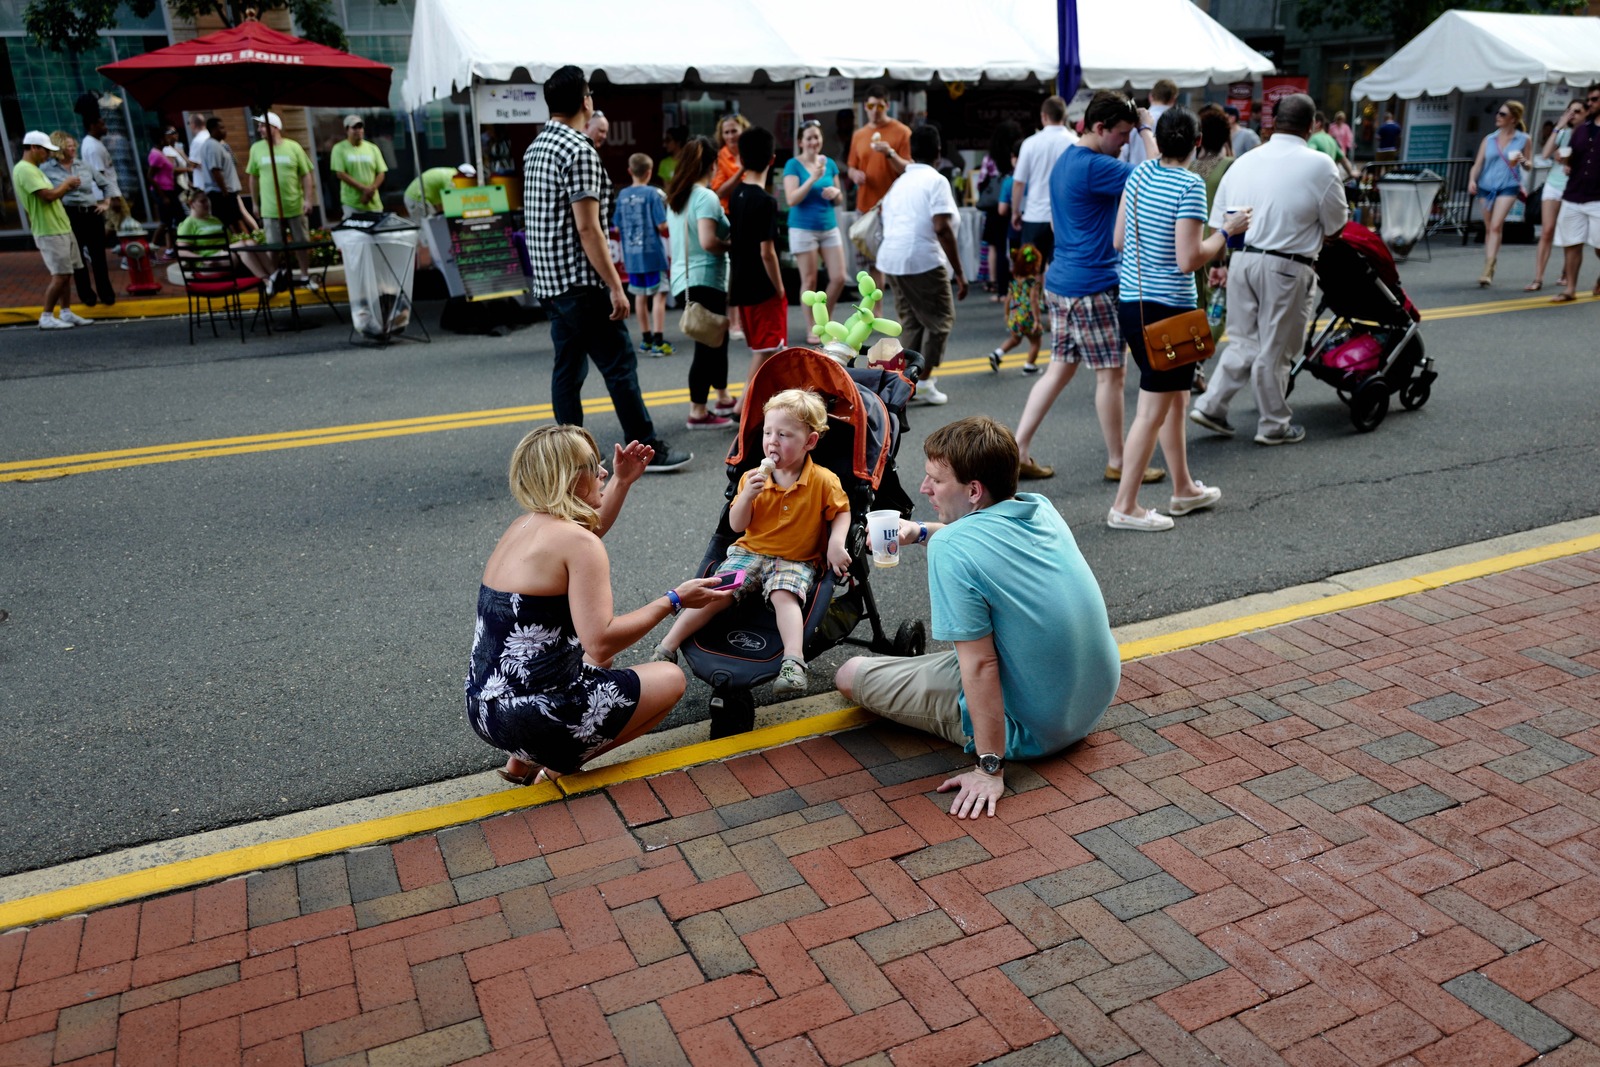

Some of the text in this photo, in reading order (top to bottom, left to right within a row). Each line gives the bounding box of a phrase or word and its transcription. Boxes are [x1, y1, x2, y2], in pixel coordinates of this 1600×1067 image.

[194, 49, 304, 66] BIG BOWL
[496, 109, 531, 118] Big Bowl
[607, 120, 637, 146] WL
